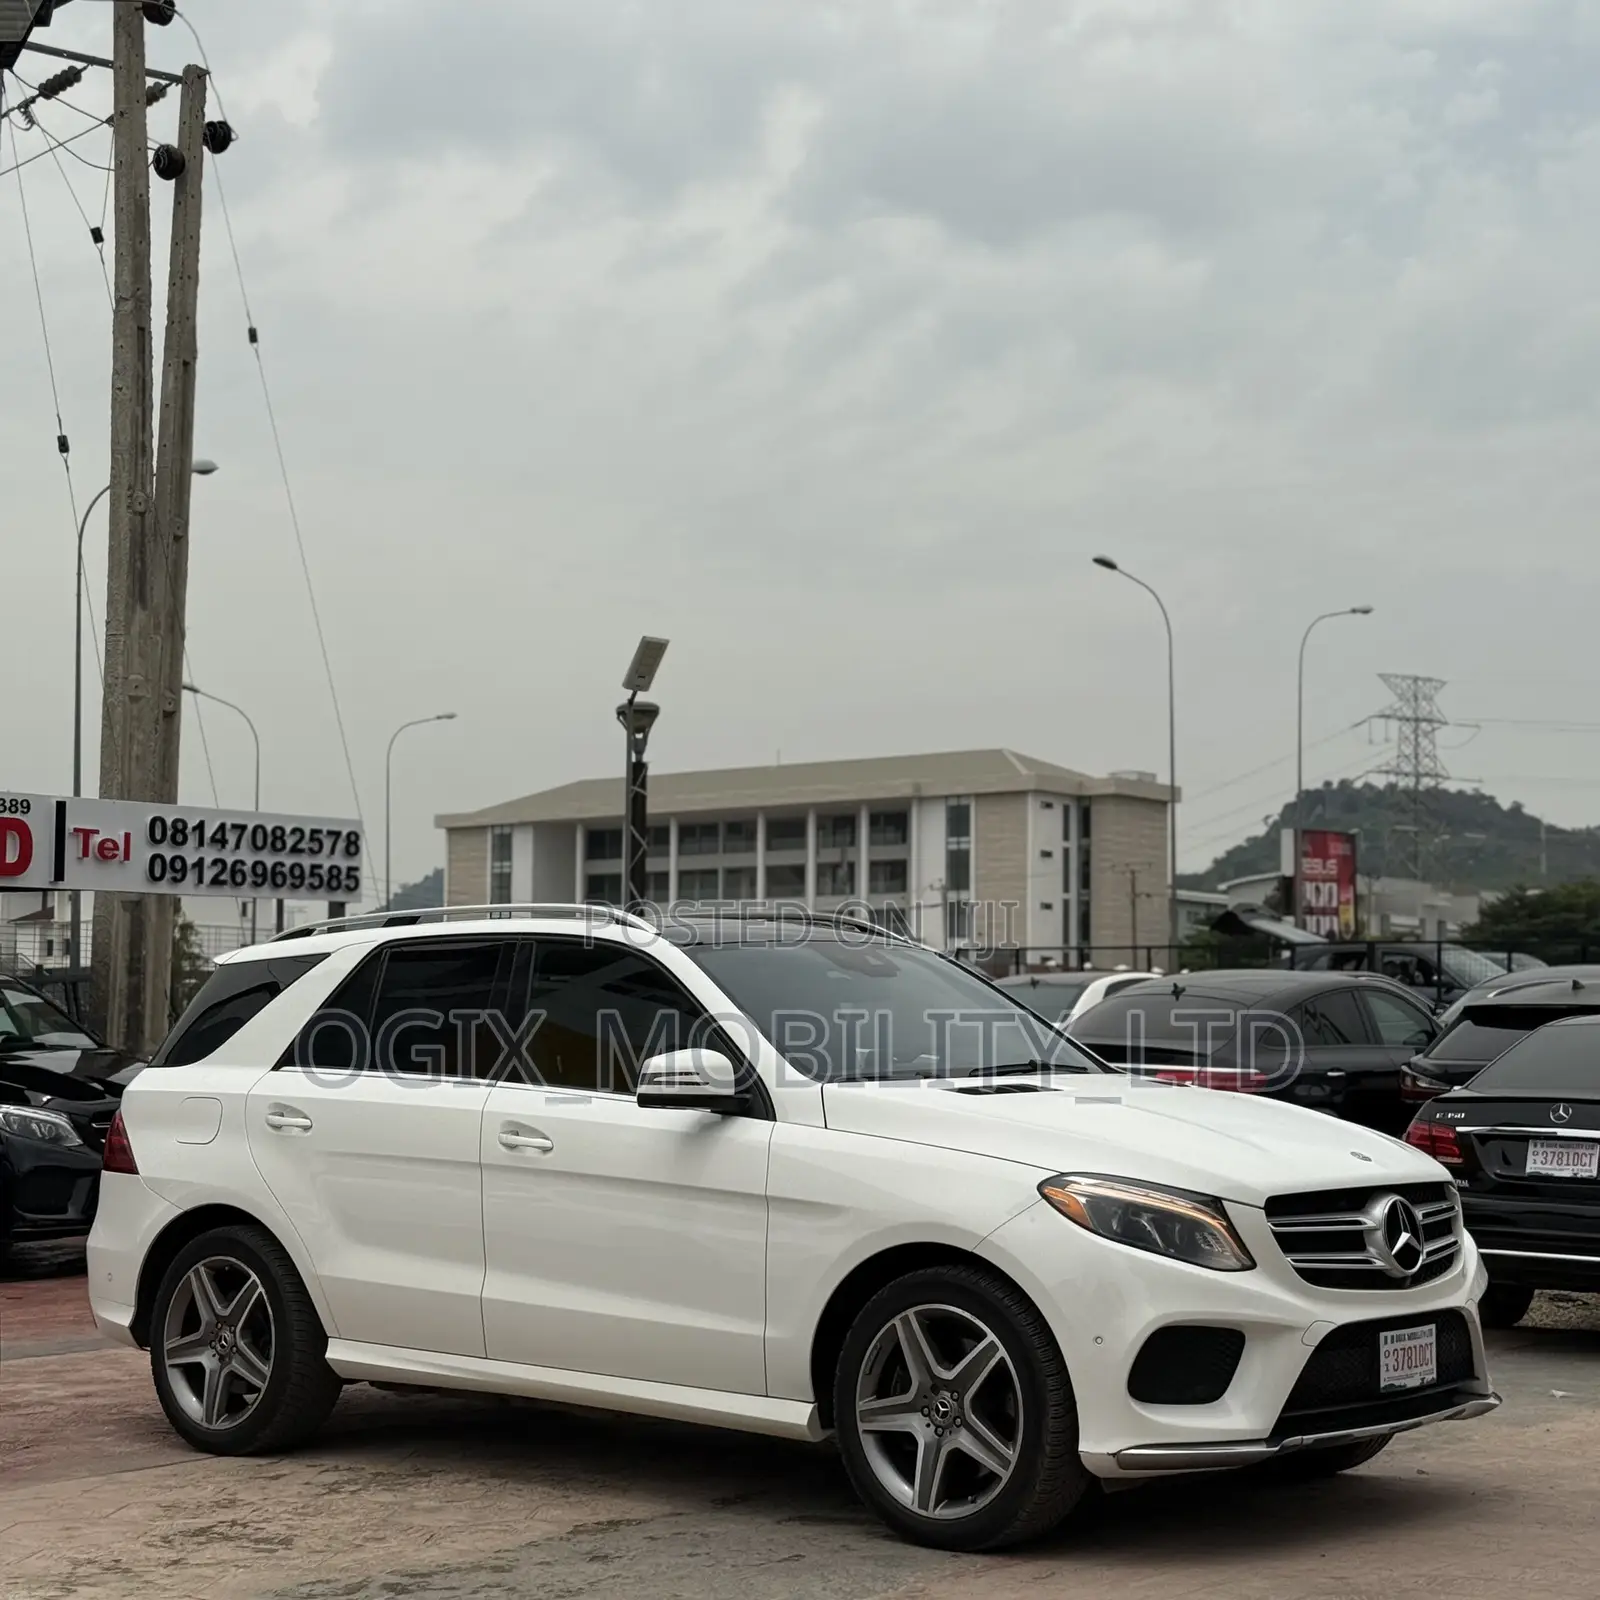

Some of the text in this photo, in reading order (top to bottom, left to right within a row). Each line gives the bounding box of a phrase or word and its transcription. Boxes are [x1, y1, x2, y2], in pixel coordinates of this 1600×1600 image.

[72, 826, 131, 862] Tel
[148, 815, 361, 857] 08147082578
[147, 853, 361, 892] 09126969585
